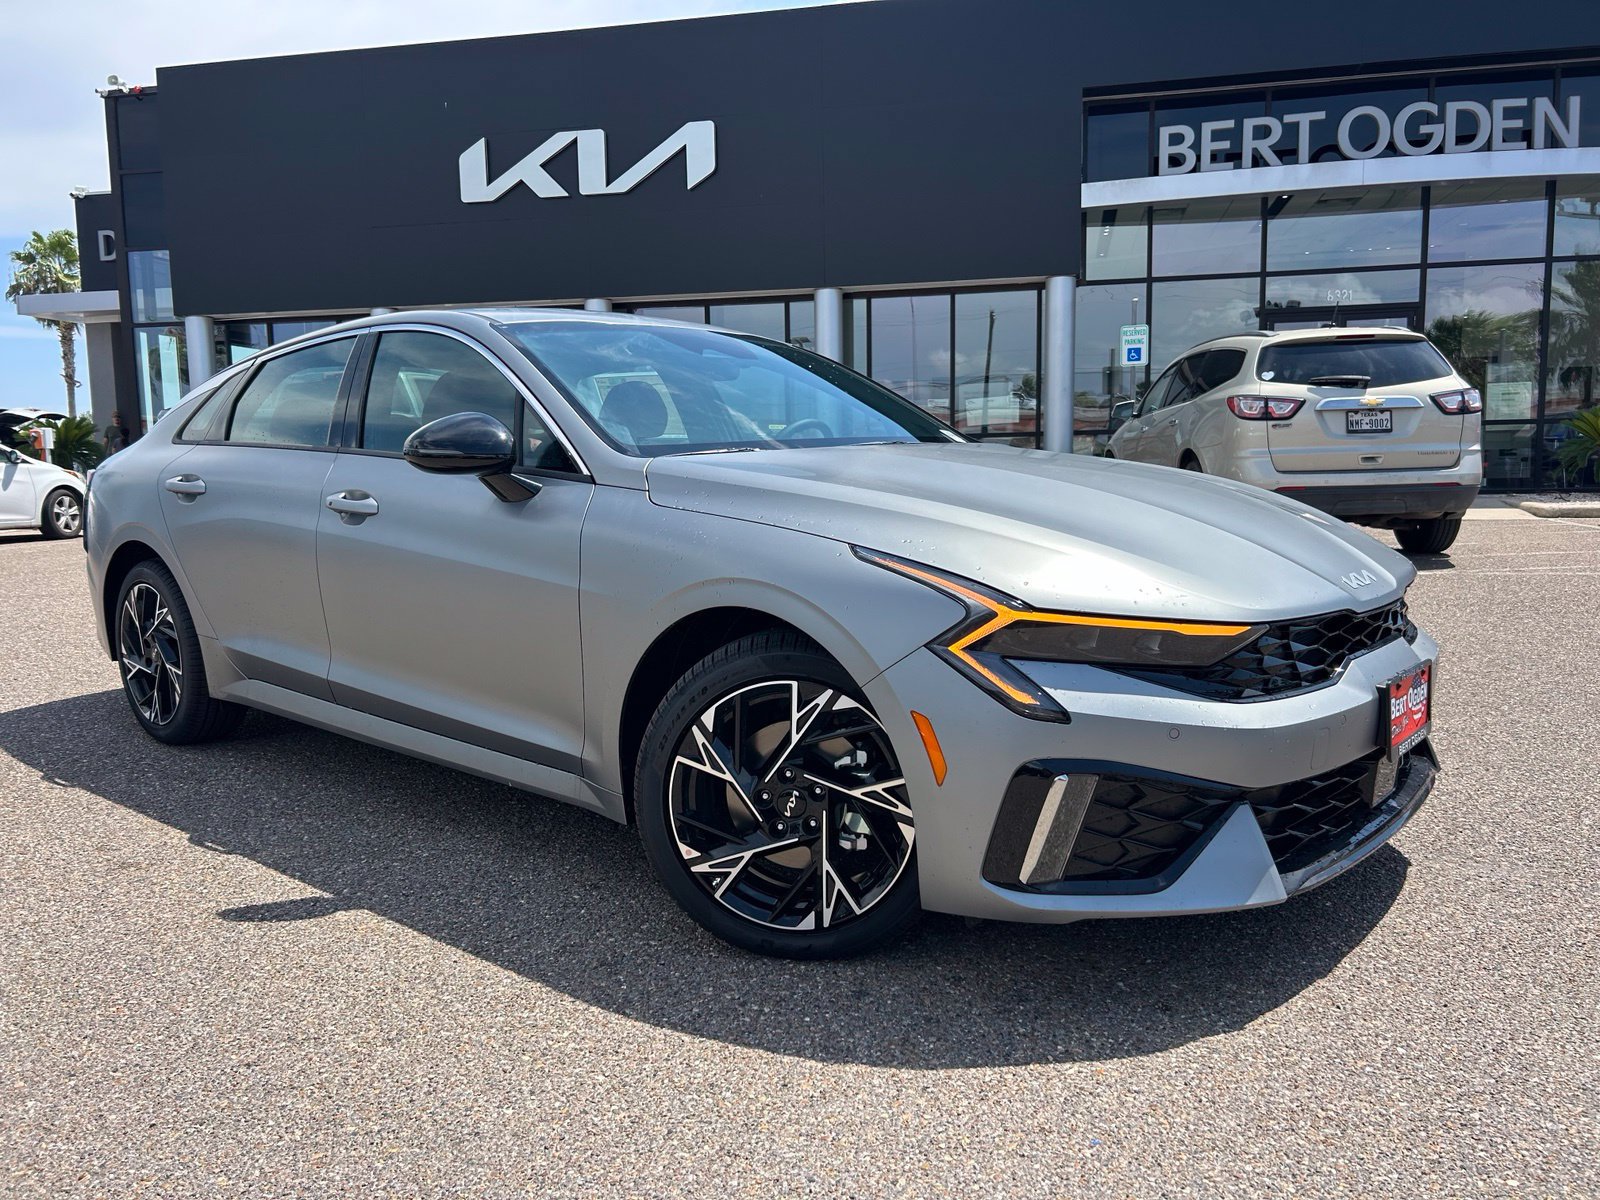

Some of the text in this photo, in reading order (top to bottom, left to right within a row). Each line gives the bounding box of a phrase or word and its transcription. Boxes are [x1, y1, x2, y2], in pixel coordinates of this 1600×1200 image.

[1158, 95, 1581, 176] BERT OGDEN
[459, 120, 716, 203] KIA
[1327, 289, 1353, 301] 6321
[1122, 329, 1146, 337] RESERVED
[1340, 569, 1377, 589] KIA
[1391, 681, 1428, 721] BERT OGDEN
